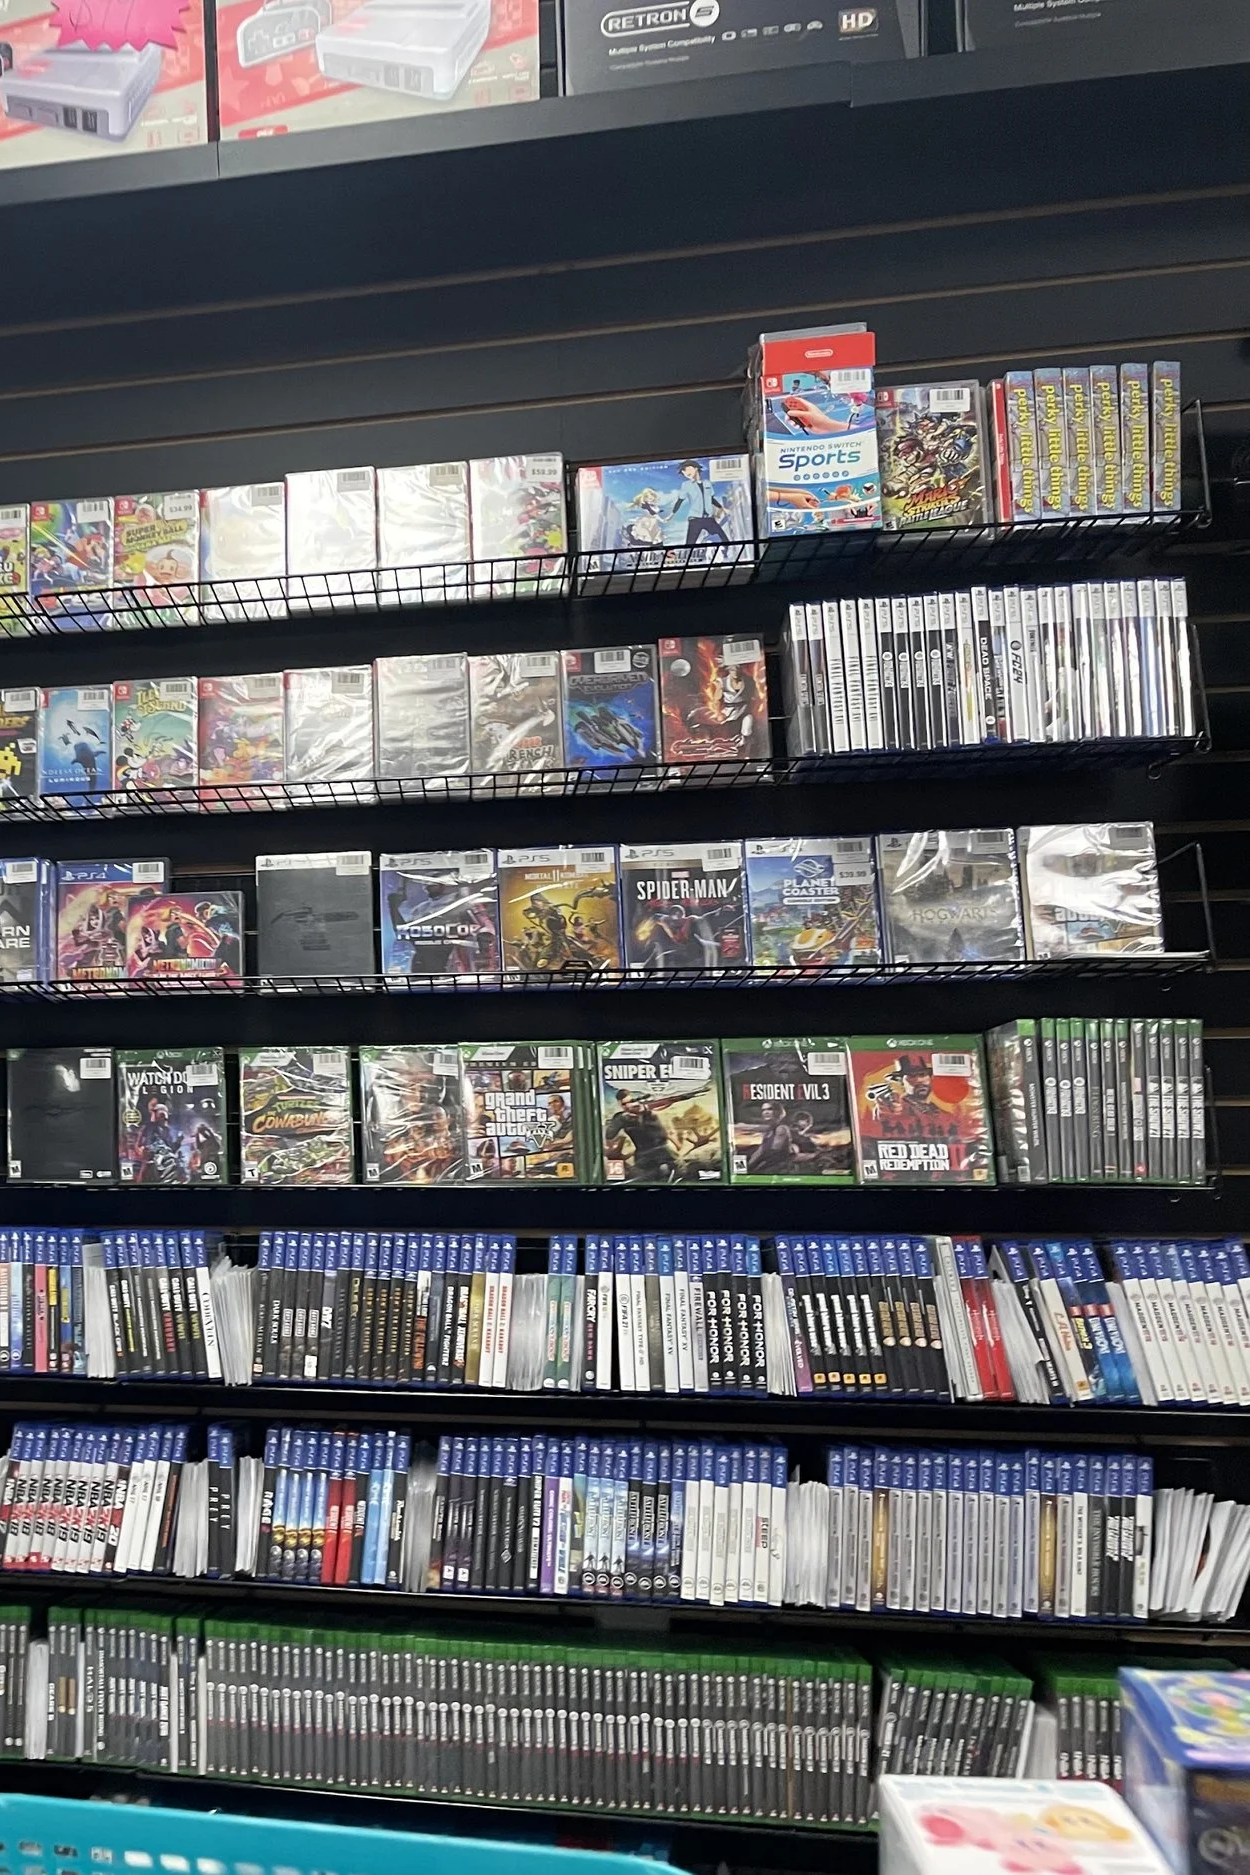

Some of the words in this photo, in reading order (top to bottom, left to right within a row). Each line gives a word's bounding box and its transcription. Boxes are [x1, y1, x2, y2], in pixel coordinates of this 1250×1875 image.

[608, 7, 687, 32] RETRON
[842, 12, 875, 29] HD
[1013, 388, 1028, 435] perky
[1041, 385, 1057, 426] perky
[1069, 384, 1084, 424] perky
[1097, 382, 1111, 423] perky
[1127, 380, 1141, 421] perky
[780, 444, 825, 454] NINTENDO
[827, 441, 862, 450] SWITCH
[1020, 433, 1033, 466] little
[1048, 428, 1063, 463] little
[1075, 428, 1089, 463] little
[1101, 426, 1116, 461] little
[1132, 425, 1146, 461] little
[778, 449, 861, 472] Sports
[1016, 468, 1035, 514] things
[1047, 466, 1064, 511] things
[1074, 465, 1093, 511] things
[1100, 464, 1119, 510] things
[1127, 463, 1145, 509] things
[929, 500, 968, 520] LEAGUE
[125, 531, 162, 545] MONKEY
[162, 524, 185, 536] BALL
[126, 524, 156, 538] SUPER
[979, 637, 989, 665] DEAD
[982, 667, 992, 700] SPACE
[518, 853, 551, 864] PS5
[641, 848, 675, 857] PS5
[637, 878, 728, 901] SPIDER-MAN
[782, 886, 839, 897] COASTER
[783, 877, 837, 889] PLANET
[911, 906, 997, 924] HOGWARTS
[128, 1071, 172, 1086] WATCH
[605, 1064, 656, 1079] SNIPER
[485, 1089, 535, 1109] grand
[742, 1084, 794, 1100] RESIDENT
[796, 1084, 820, 1100] EVIL
[822, 1083, 830, 1100] 3
[495, 1108, 548, 1124] theft
[485, 1122, 527, 1137] auto
[878, 1143, 907, 1159] RED
[909, 1143, 949, 1159] DEAD
[880, 1159, 949, 1171] REDEMPTION
[158, 1278, 168, 1293] CALL
[172, 1278, 182, 1293] CALL
[187, 1277, 196, 1293] CALL
[160, 1295, 171, 1311] DUTY
[174, 1295, 183, 1312] DUTY
[188, 1294, 198, 1312] DUTY
[272, 1300, 280, 1319] DARK
[446, 1286, 454, 1313] DRAGON
[694, 1288, 703, 1332] FIREWALL
[706, 1291, 718, 1316] FOR
[721, 1290, 733, 1314] FOR
[737, 1293, 749, 1318] FOR
[751, 1295, 763, 1319] FOR
[270, 1320, 279, 1344] SOULS
[445, 1314, 453, 1329] BALL
[680, 1310, 688, 1339] FANTASY
[442, 1335, 450, 1366] FIGHTERZ
[534, 1476, 542, 1499] SNIPER
[209, 1487, 219, 1523] PREY
[221, 1494, 231, 1530] PREY
[262, 1491, 273, 1524] RAGE
[86, 1666, 94, 1703] HALO
